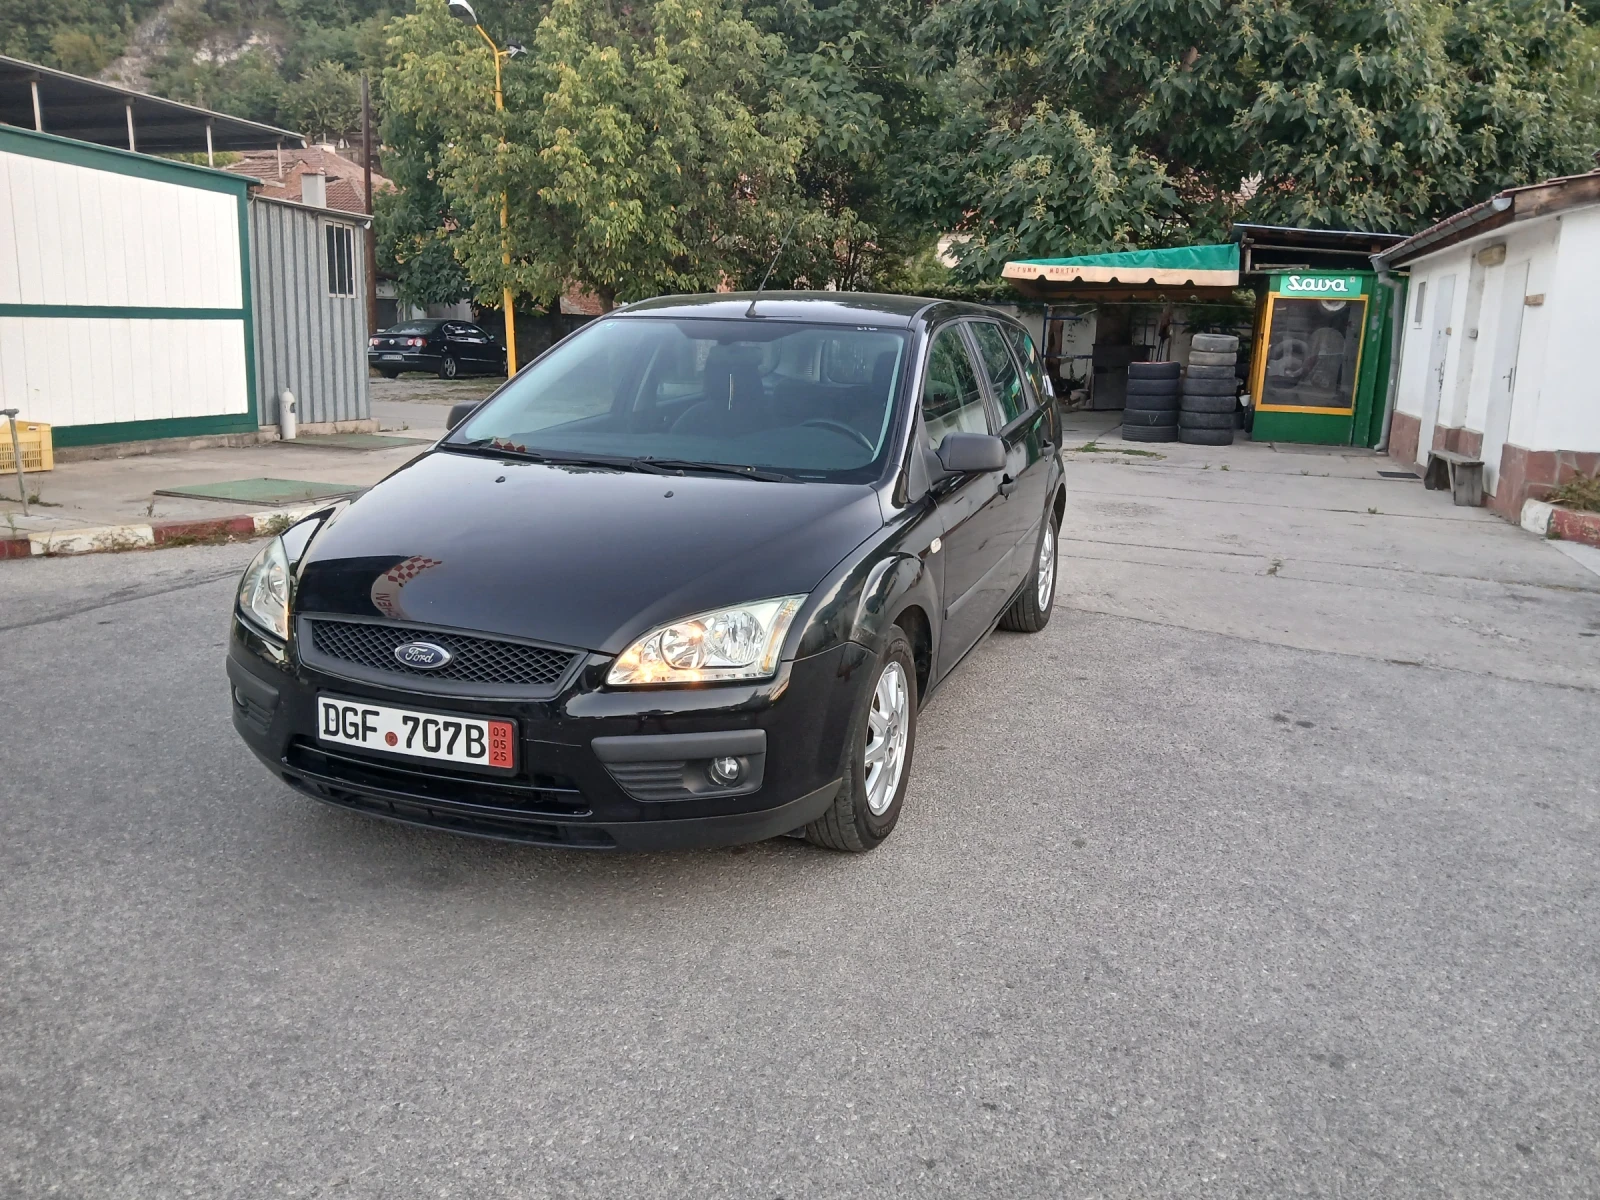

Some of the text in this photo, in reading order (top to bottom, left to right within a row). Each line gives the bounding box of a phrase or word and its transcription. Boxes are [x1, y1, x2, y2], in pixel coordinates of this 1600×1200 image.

[1287, 275, 1349, 292] Sava
[405, 646, 435, 663] Ford
[322, 702, 487, 759] DGF 707B
[493, 726, 507, 738] 03
[493, 738, 507, 750] 05
[493, 751, 507, 762] 25
